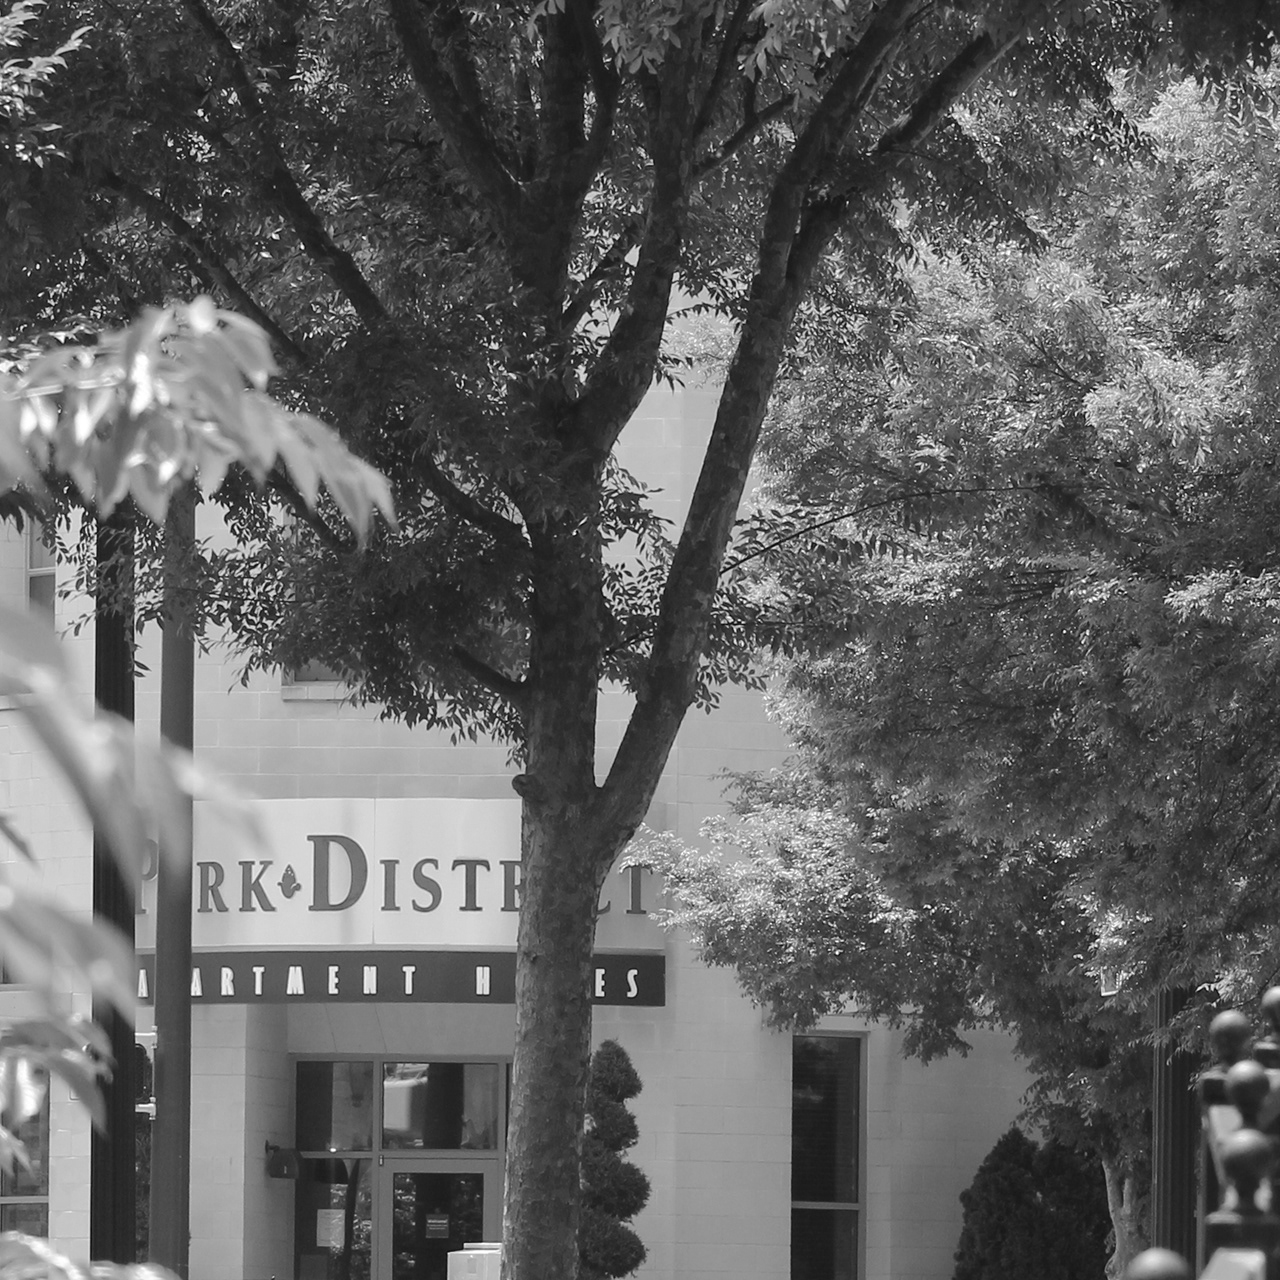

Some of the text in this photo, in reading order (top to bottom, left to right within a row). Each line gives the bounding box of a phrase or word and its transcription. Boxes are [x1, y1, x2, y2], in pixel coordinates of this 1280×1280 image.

[134, 838, 277, 913] PRK
[138, 966, 638, 998] AARTMENT HES
